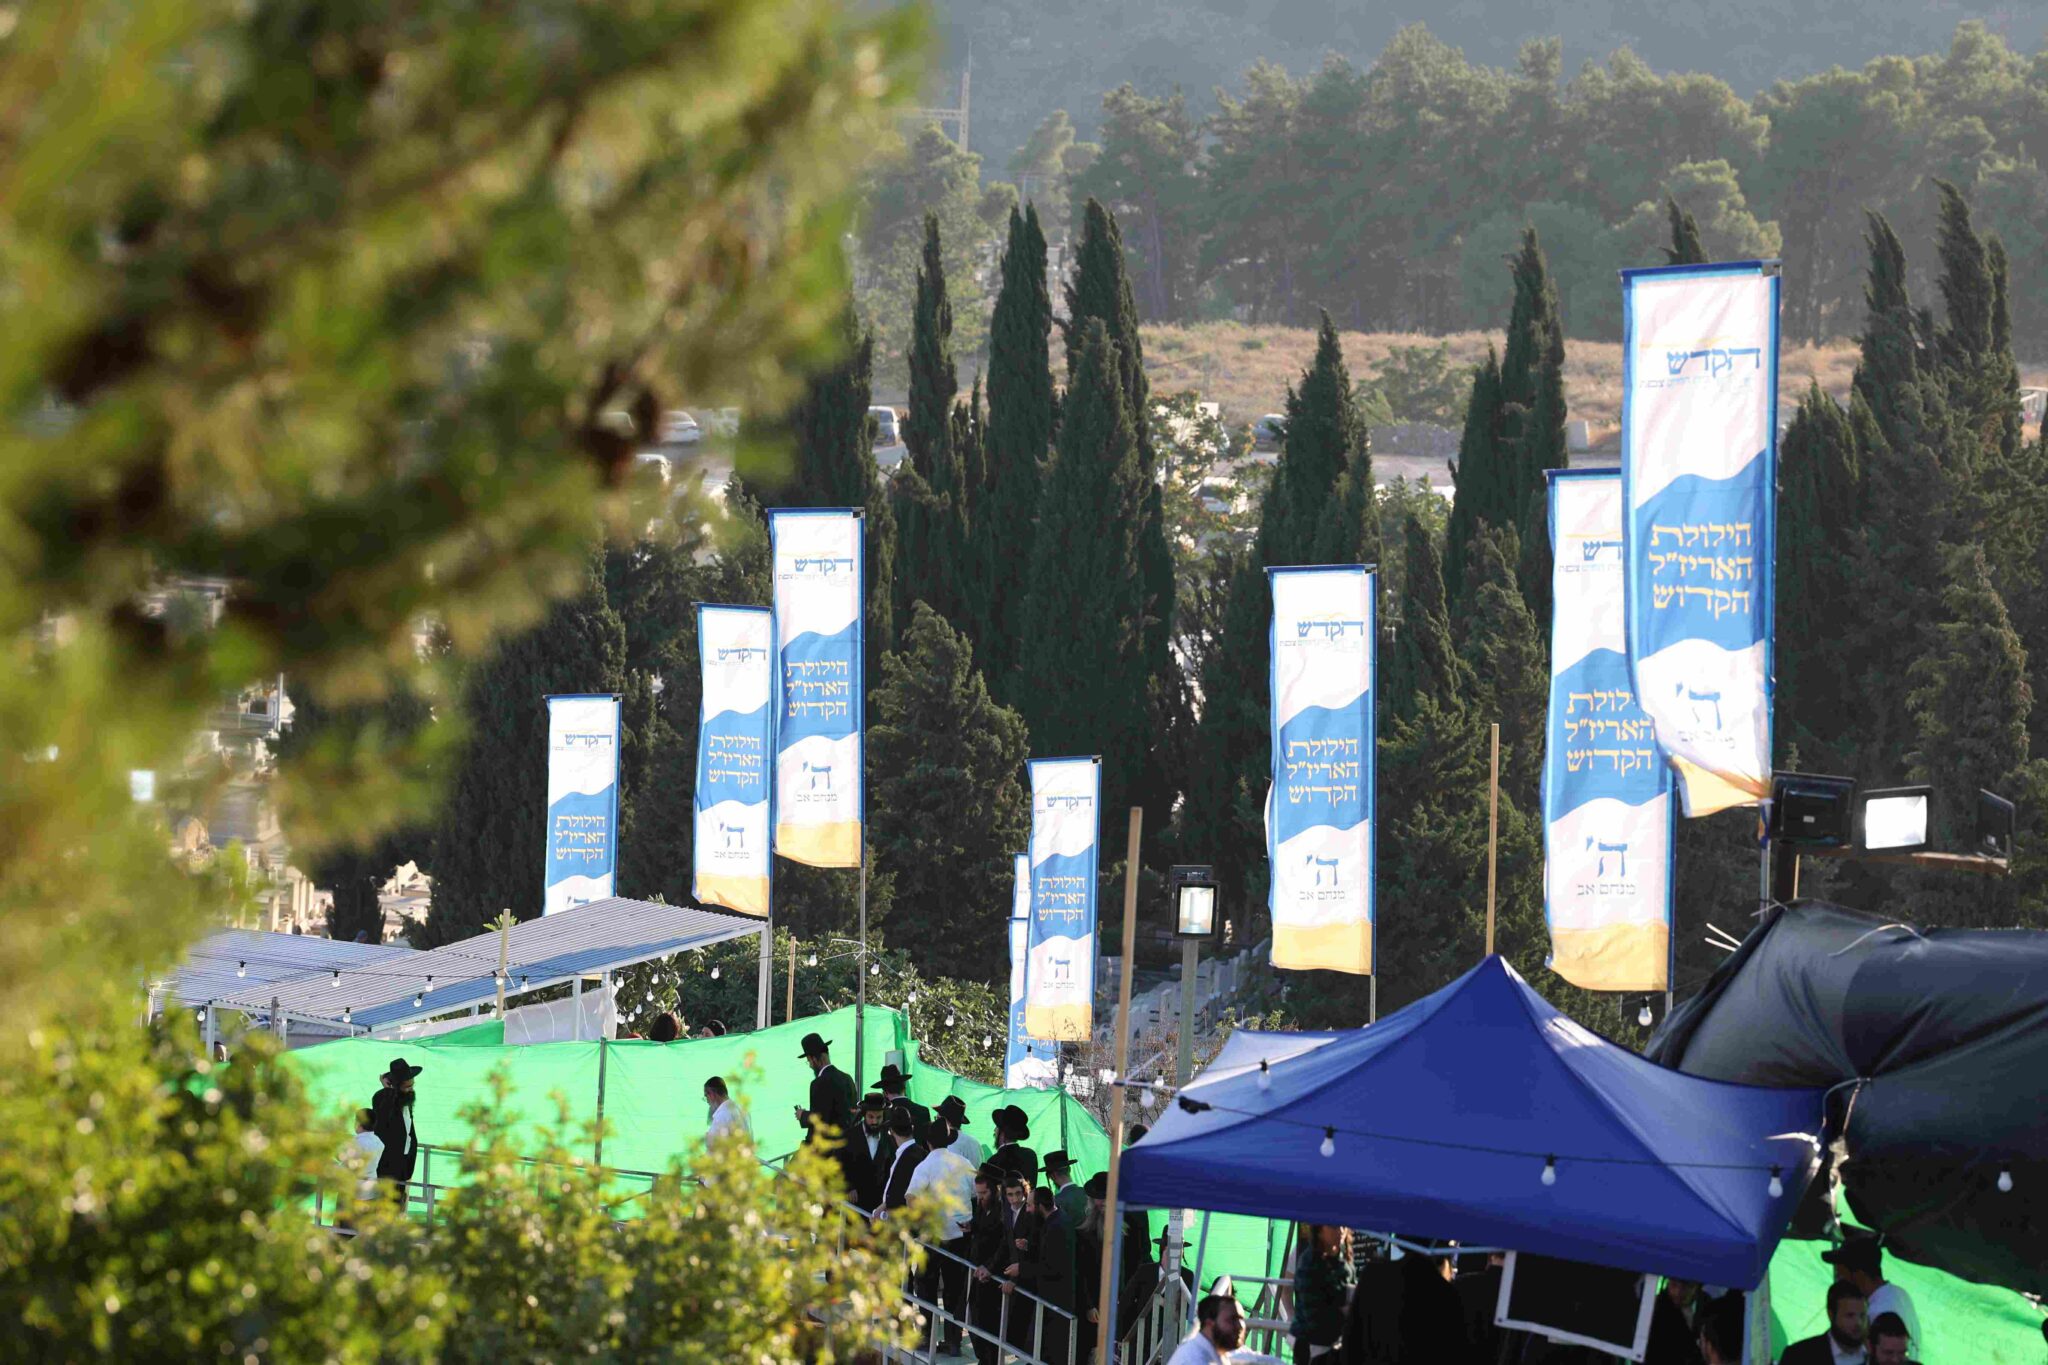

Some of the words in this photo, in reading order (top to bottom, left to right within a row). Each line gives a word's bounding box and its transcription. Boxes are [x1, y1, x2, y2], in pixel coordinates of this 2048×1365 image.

[1667, 348, 1760, 378] הקדש
[1650, 522, 1751, 548] הילולת
[1583, 541, 1622, 561] דש
[794, 558, 853, 576] הקדש
[1653, 583, 1750, 621] הקדוש
[1297, 621, 1364, 641] הקדש
[717, 648, 766, 663] הקדש
[786, 660, 848, 677] הילולת
[788, 700, 847, 721] הקדוש
[565, 733, 612, 748] הקדש
[709, 733, 760, 750] הילולת
[1288, 737, 1358, 757] הילולת
[1566, 747, 1652, 778] הקדוש
[708, 769, 759, 789] הקדוש
[1046, 795, 1092, 810] הקדש
[1288, 785, 1357, 808] הקדוש
[555, 814, 605, 828] הילולת
[555, 847, 604, 865] הקדוש
[1038, 875, 1085, 889] הילולת
[1038, 908, 1084, 926] הקדוש
